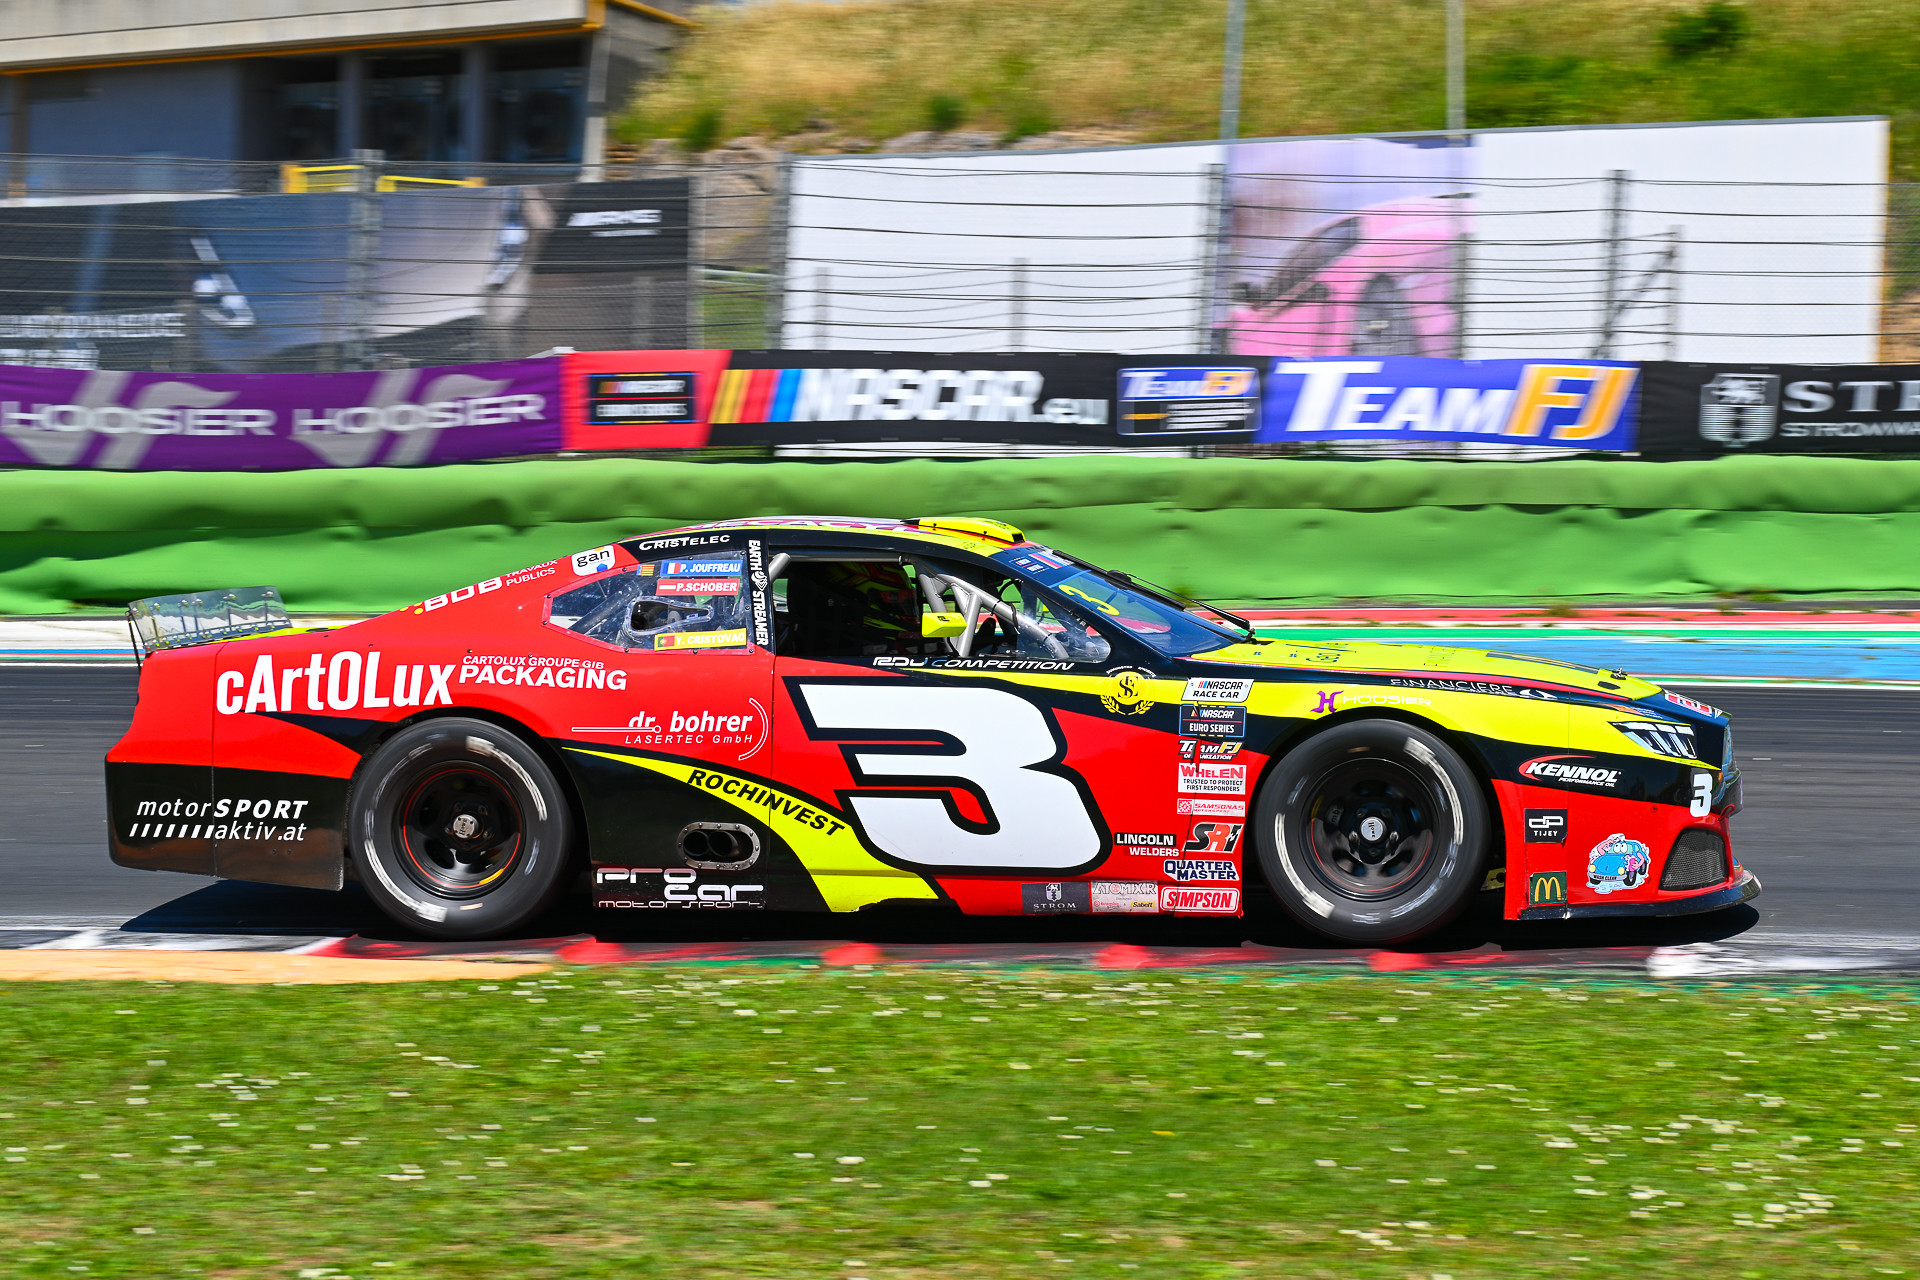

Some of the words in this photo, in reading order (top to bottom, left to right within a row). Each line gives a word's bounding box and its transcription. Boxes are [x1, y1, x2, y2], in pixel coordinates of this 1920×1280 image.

[638, 535, 730, 551] CRISTELEC
[576, 550, 610, 568] gan
[748, 539, 762, 571] EARTH
[680, 563, 687, 572] P.
[690, 563, 741, 573] JOUFFREAU
[506, 567, 556, 587] PUBLICS
[752, 590, 769, 646] STREAMER
[674, 635, 686, 645] Y.
[462, 655, 526, 666] CARTOLUX
[528, 658, 580, 668] GROUPE
[583, 661, 604, 669] GIB
[931, 659, 1075, 671] COMPETITION
[216, 651, 456, 715] cArtOLux
[458, 664, 627, 691] PACKAGING
[1206, 680, 1244, 690] NASCAR
[1192, 690, 1218, 698] RACE
[1219, 691, 1240, 699] CAR
[1342, 694, 1432, 708] HOOSIER
[1200, 709, 1235, 719] NASCAR
[669, 710, 754, 733] bohrer
[1189, 722, 1209, 733] EURO
[1209, 724, 1235, 734] SERIES
[624, 734, 705, 745] LASERTEC
[712, 734, 754, 744] GmbH
[798, 684, 1101, 869] 3
[1180, 764, 1245, 779] WHELEN
[1524, 761, 1619, 783] KENNOL
[1203, 785, 1240, 793] RESPONDERS
[1217, 779, 1243, 787] PROTECT
[1689, 773, 1713, 818] 3
[687, 769, 846, 837] ROCHINVEST
[1194, 803, 1244, 811] SAMSONAS
[214, 821, 307, 841] aktiv.at
[1116, 833, 1174, 846] LINCOLN
[1129, 847, 1180, 857] WELDERS
[1165, 860, 1233, 874] QUARTER
[596, 867, 698, 884] pro
[1177, 868, 1237, 881] MASTER
[1033, 902, 1077, 910] STROM
[1167, 892, 1232, 909] SIMPSON
